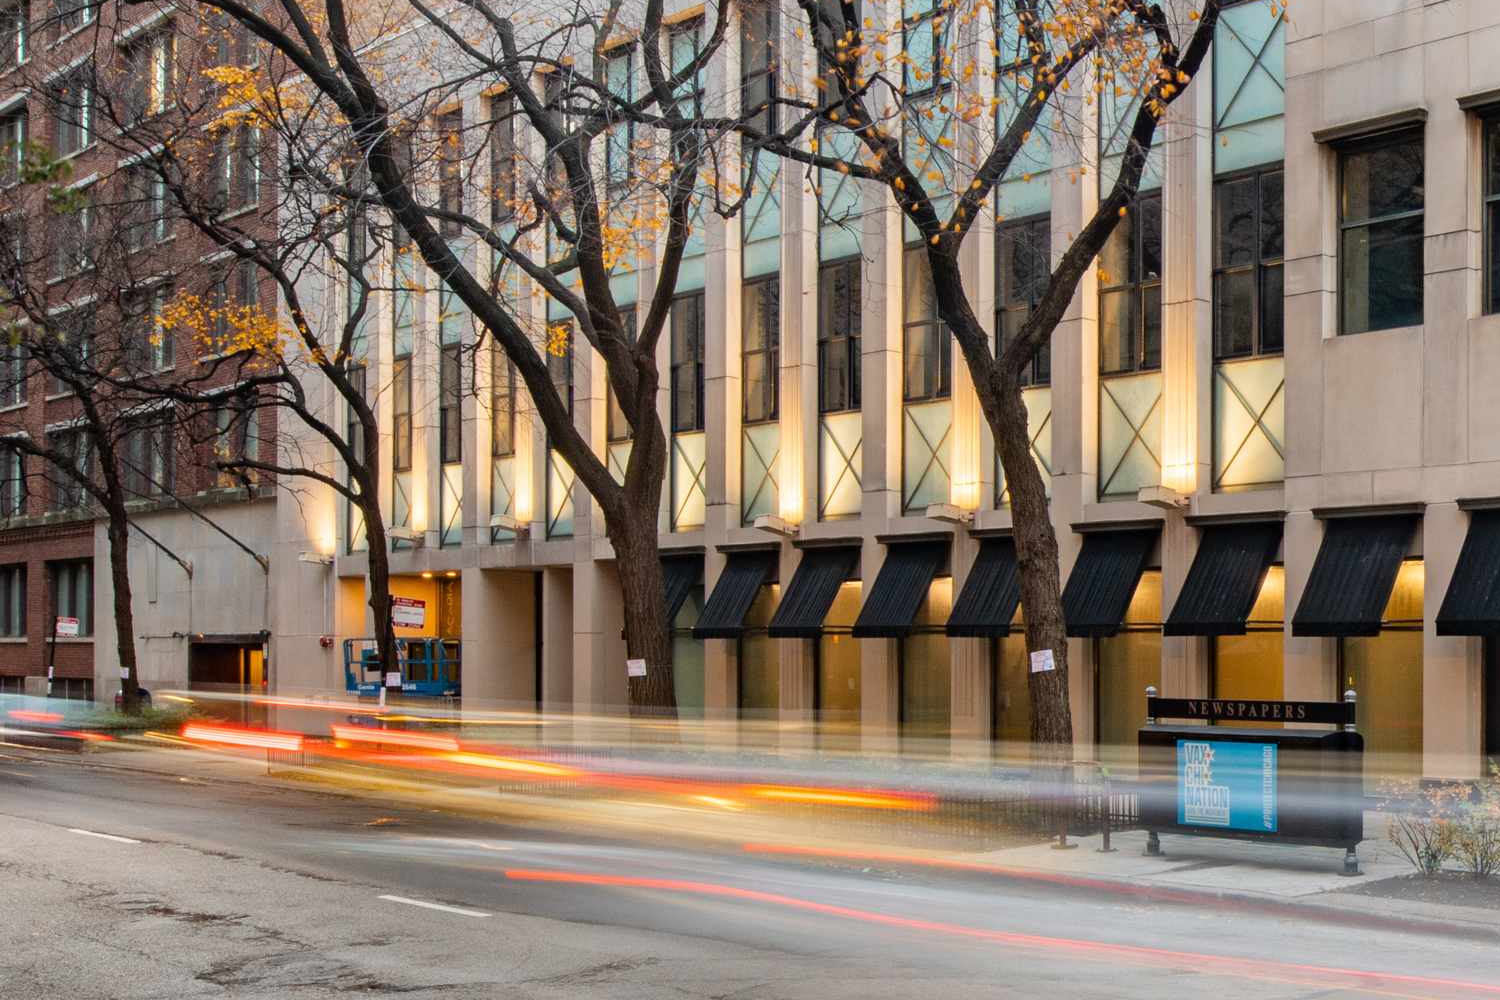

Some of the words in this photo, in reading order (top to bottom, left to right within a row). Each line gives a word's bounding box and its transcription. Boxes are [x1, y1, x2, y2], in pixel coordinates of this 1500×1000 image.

[1188, 701, 1305, 719] NEWSPAPERS
[1186, 744, 1208, 765] VAX
[1186, 786, 1228, 808] NATION
[1263, 745, 1272, 829] #PROTECTCHICAGO
